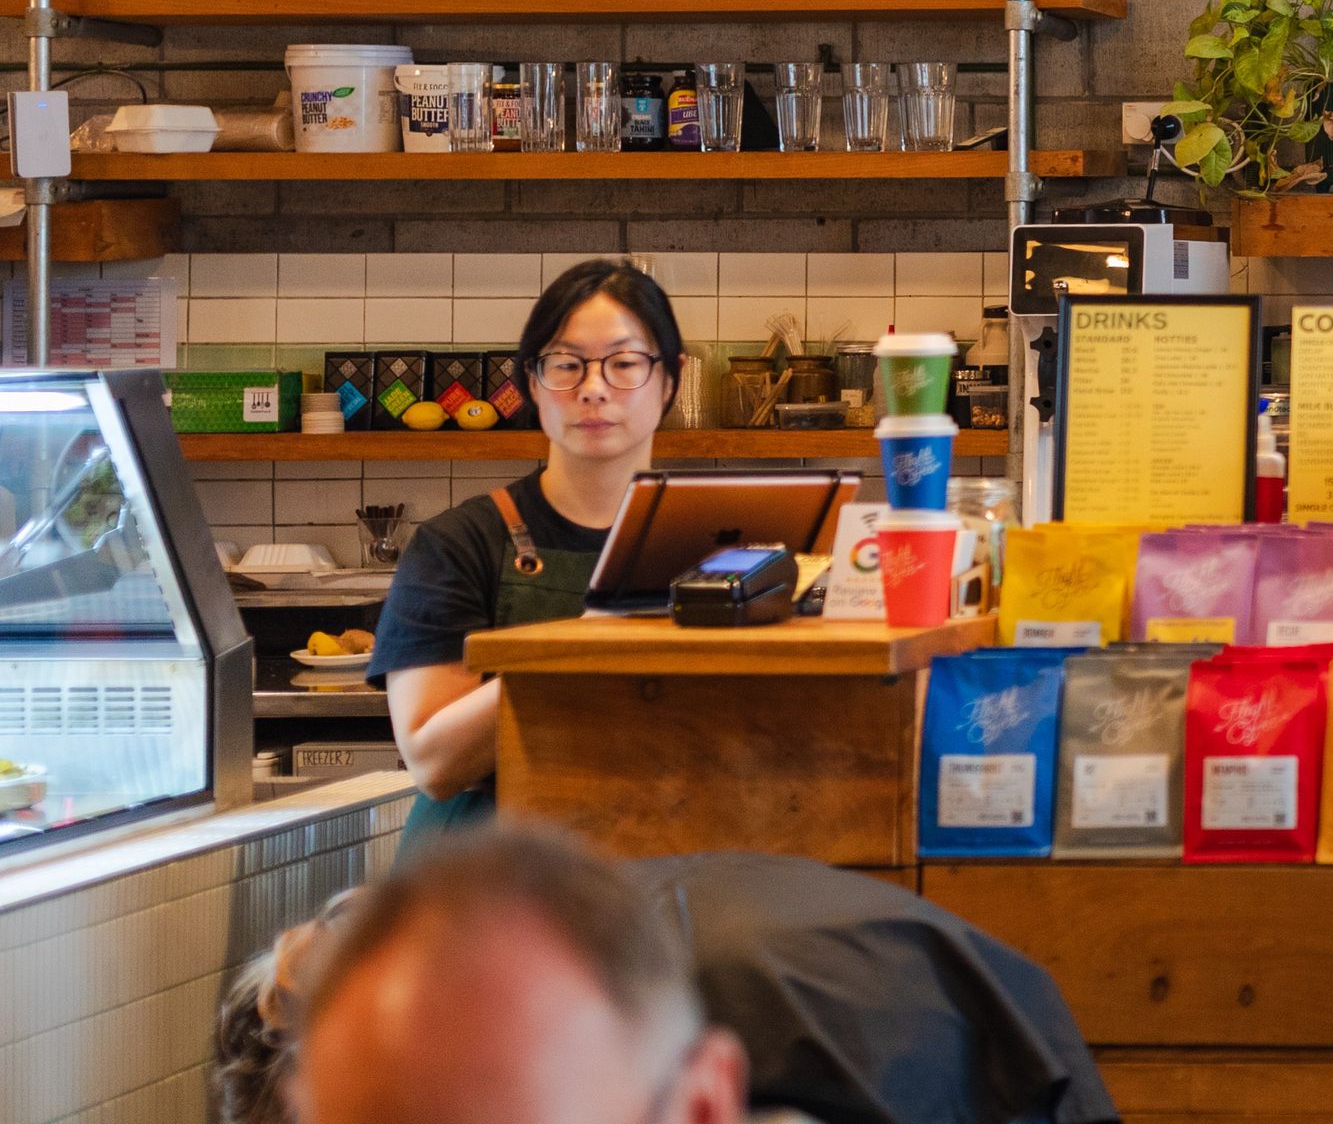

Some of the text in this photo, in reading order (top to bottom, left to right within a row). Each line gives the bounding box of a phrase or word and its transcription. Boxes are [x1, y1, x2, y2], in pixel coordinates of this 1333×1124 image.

[301, 91, 332, 102] CRUNCHY
[302, 102, 328, 114] PEANUT
[302, 113, 328, 125] BUTTER
[630, 125, 655, 133] TAHINI
[1076, 312, 1168, 330] DRINKS
